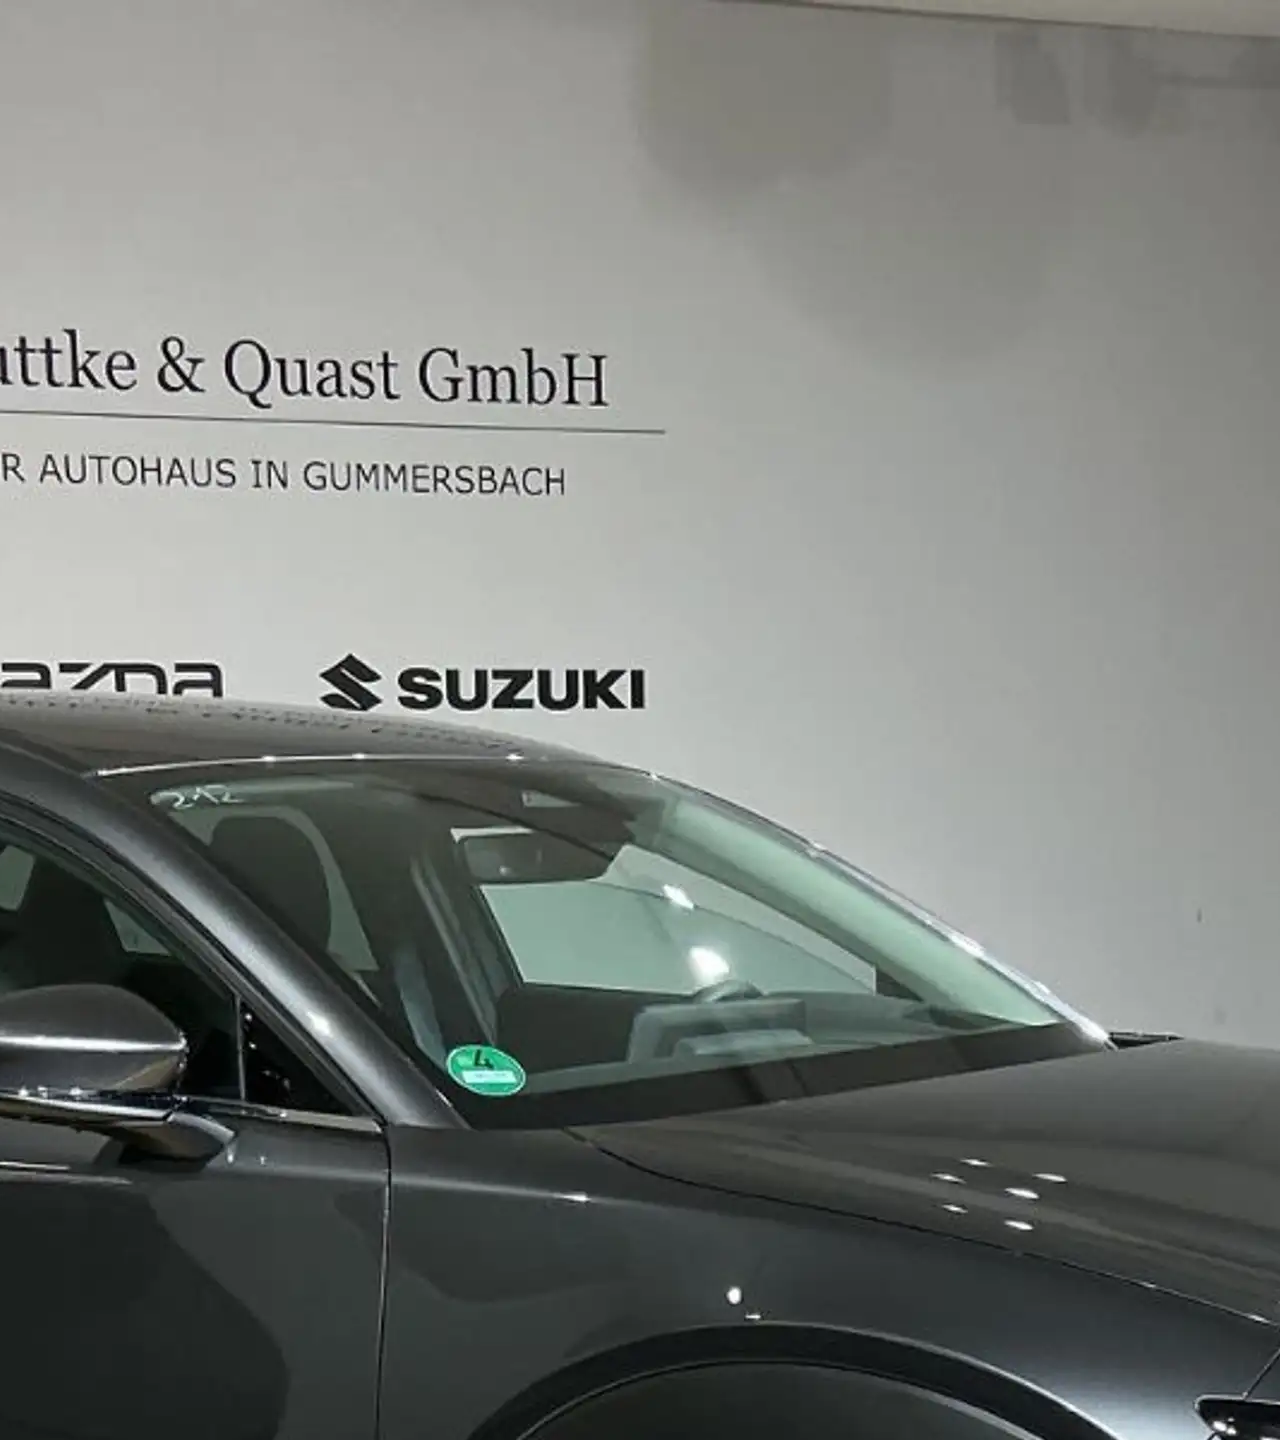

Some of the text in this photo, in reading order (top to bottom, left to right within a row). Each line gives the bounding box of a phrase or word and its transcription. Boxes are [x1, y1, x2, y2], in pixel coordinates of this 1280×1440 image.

[157, 336, 206, 393] &
[225, 339, 401, 409] Quast
[419, 348, 608, 406] GmbH
[39, 454, 236, 488] AUTOHAUS
[251, 459, 288, 489] IN
[304, 461, 564, 496] GUMMERSBACH
[398, 668, 646, 711] SUZUKI
